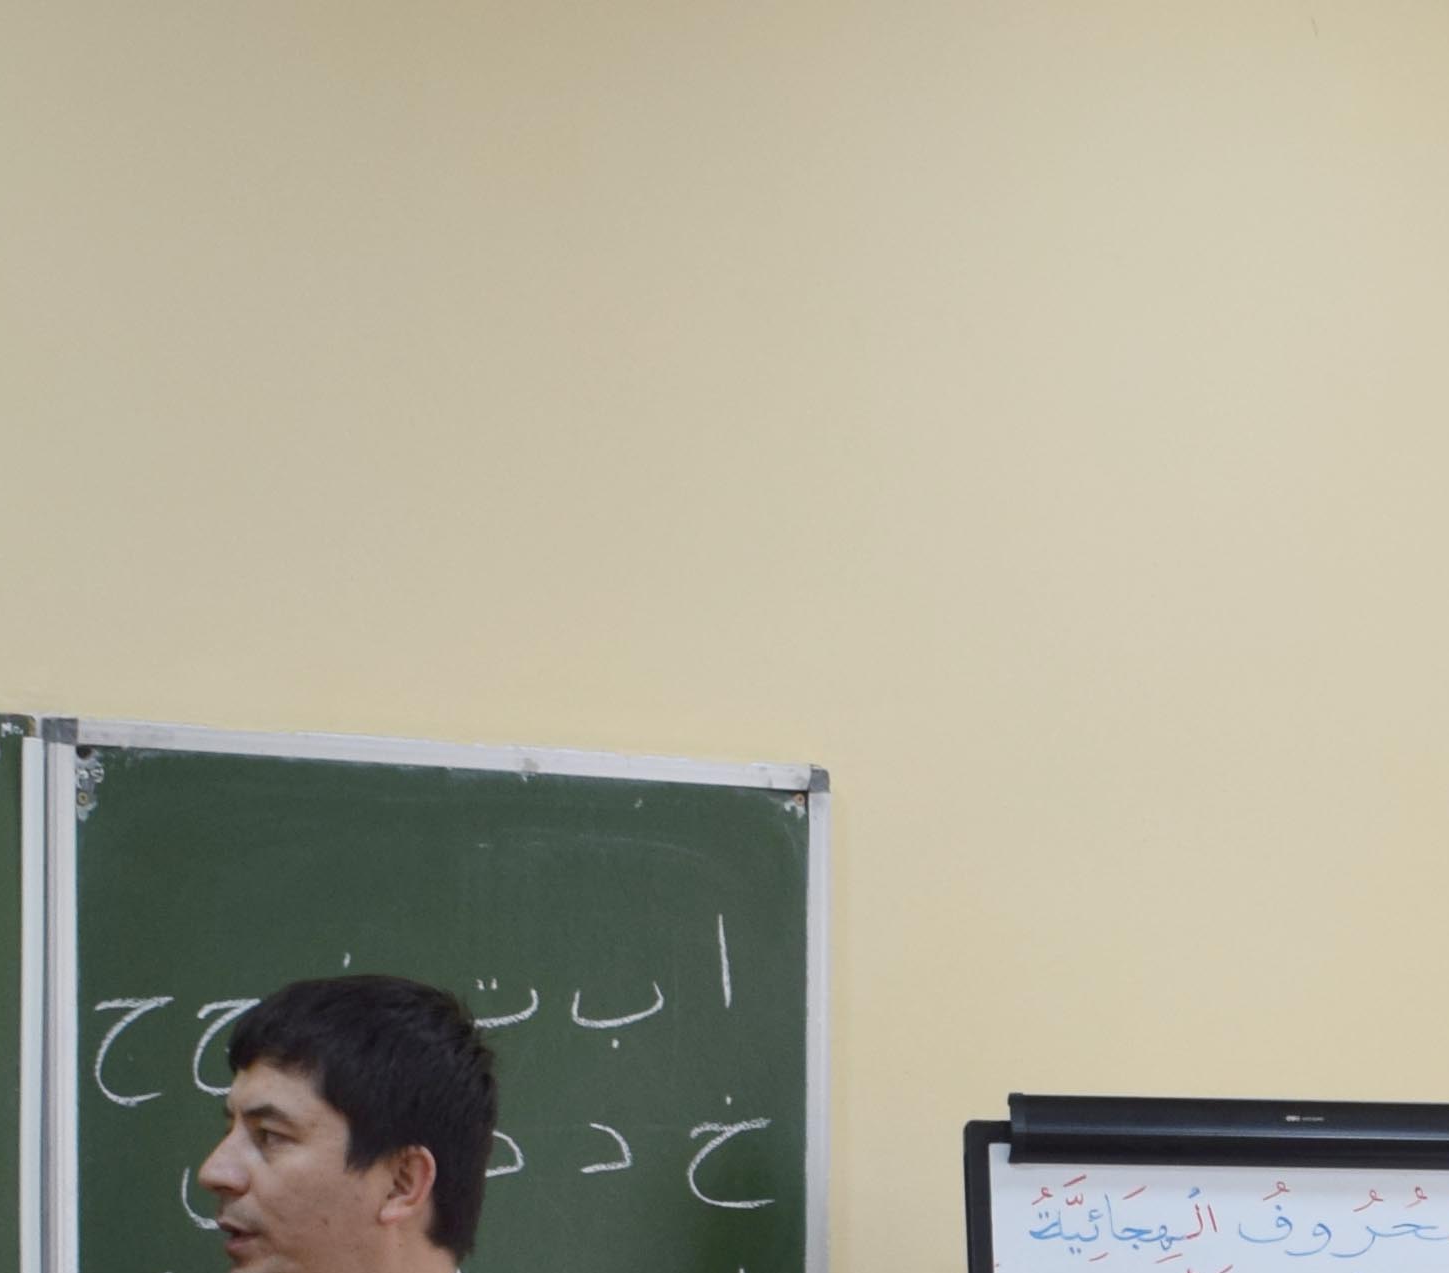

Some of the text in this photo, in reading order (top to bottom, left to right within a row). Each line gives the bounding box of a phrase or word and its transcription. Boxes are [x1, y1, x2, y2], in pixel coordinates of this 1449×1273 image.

[94, 996, 175, 1107] ح
[571, 980, 665, 1049] ب
[580, 1121, 633, 1174] د
[686, 1094, 776, 1209] خ
